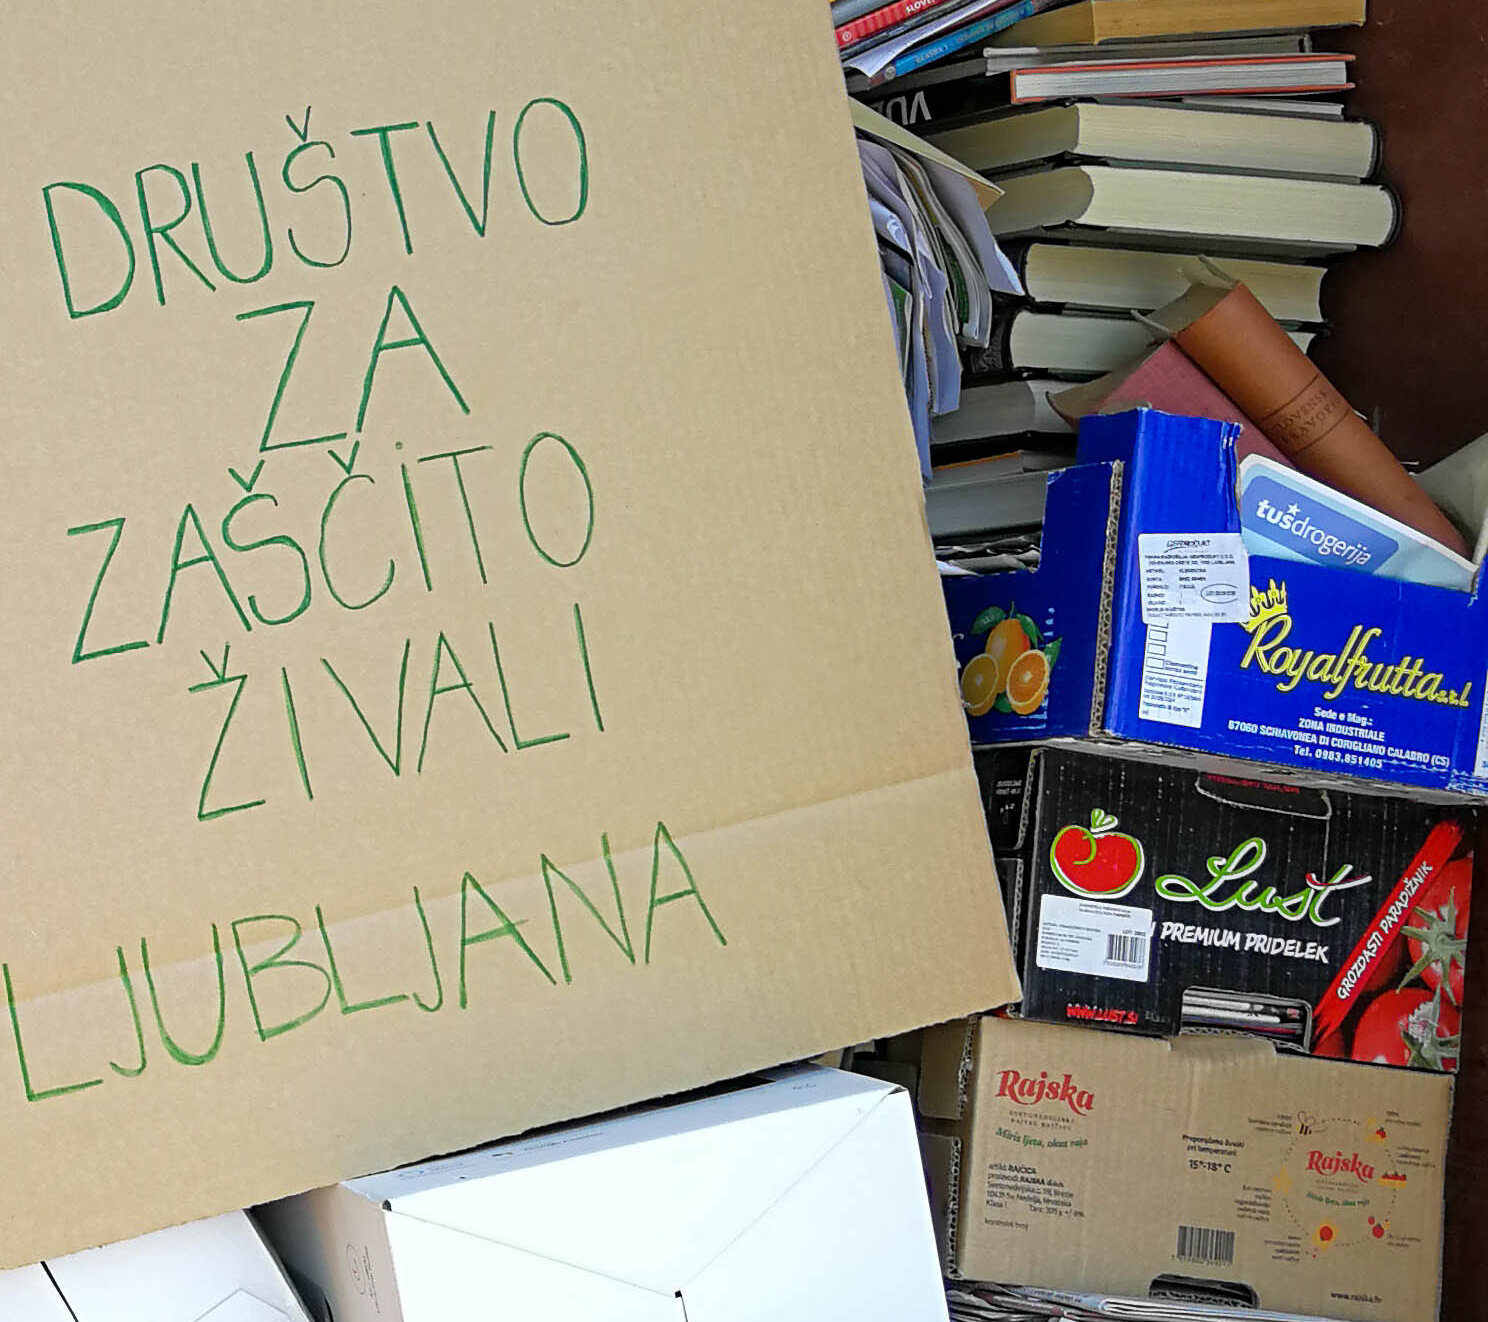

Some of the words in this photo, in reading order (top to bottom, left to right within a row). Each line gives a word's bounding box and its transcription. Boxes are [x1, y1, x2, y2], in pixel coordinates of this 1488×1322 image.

[42, 96, 590, 320] DRUŠTVO
[235, 285, 470, 454] ZA
[66, 431, 595, 665] ZAŠČITO
[1240, 615, 1442, 700] Royalfrutta
[188, 602, 605, 821] ŽIVALI
[1298, 718, 1323, 732] ZONA
[1326, 722, 1385, 741] INDUSTRIALE
[1314, 707, 1337, 720] Sede
[1259, 726, 1317, 744] SCHIAVONEA
[1319, 734, 1329, 746] DI
[1331, 737, 1386, 756] CORIGLIANO
[1387, 747, 1429, 764] CALABRO
[1431, 754, 1450, 768] (CS)
[1294, 745, 1312, 757] Tel.
[2, 821, 727, 1102] LJUBLJANA
[1162, 922, 1241, 950] PREMIUM
[1245, 934, 1330, 964] PRIDELEK
[1336, 928, 1384, 1001] GROZDASTI
[1381, 860, 1433, 936] PARADIŽNIK
[995, 1070, 1095, 1116] Rajska
[1305, 1150, 1375, 1183] Rajska
